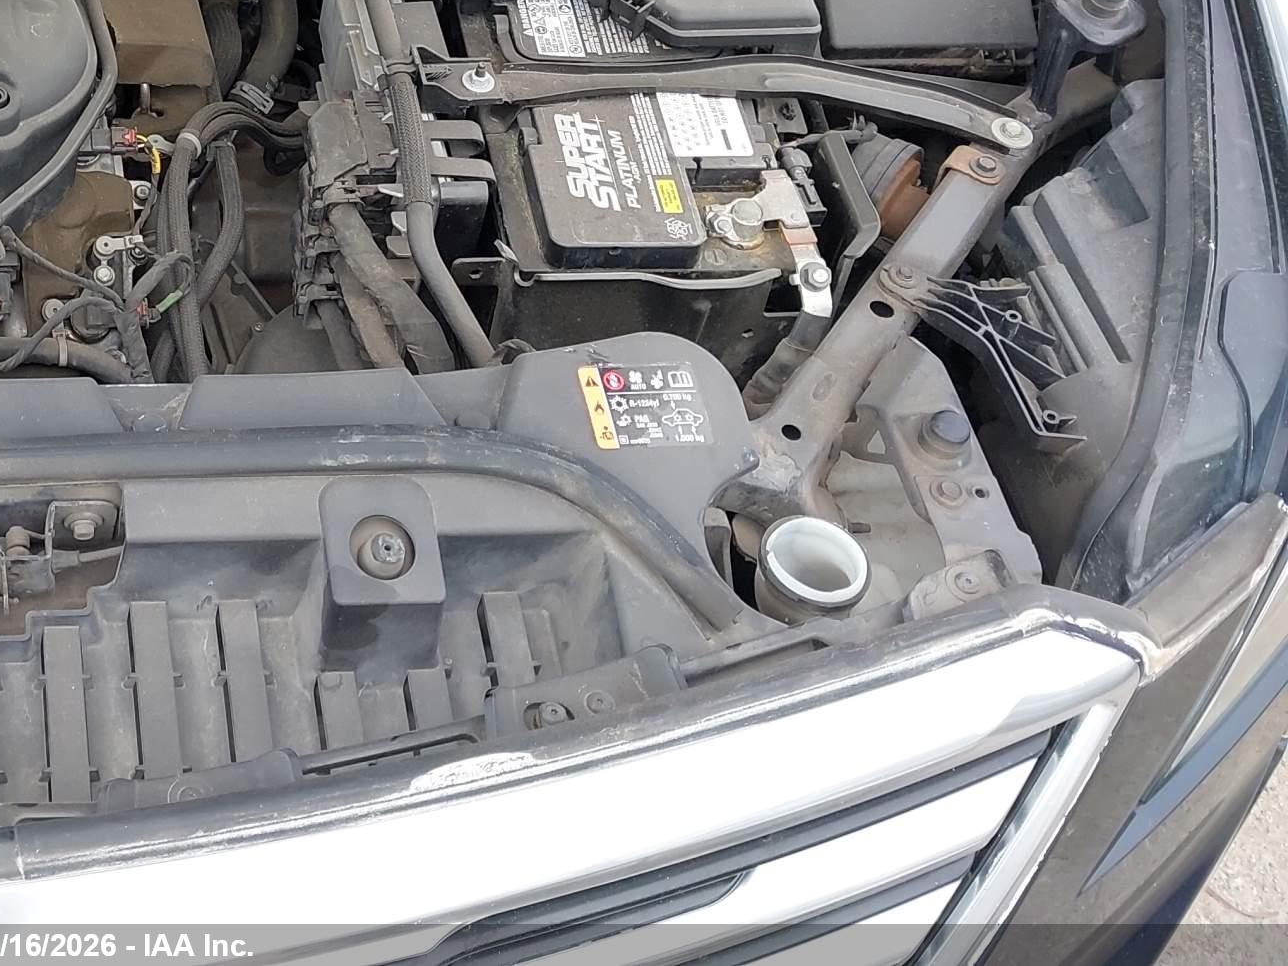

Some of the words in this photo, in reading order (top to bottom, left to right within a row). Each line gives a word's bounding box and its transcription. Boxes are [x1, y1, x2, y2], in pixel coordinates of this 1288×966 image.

[554, 113, 588, 198] SUPER
[572, 111, 622, 212] START
[607, 129, 641, 209] PLATINUM
